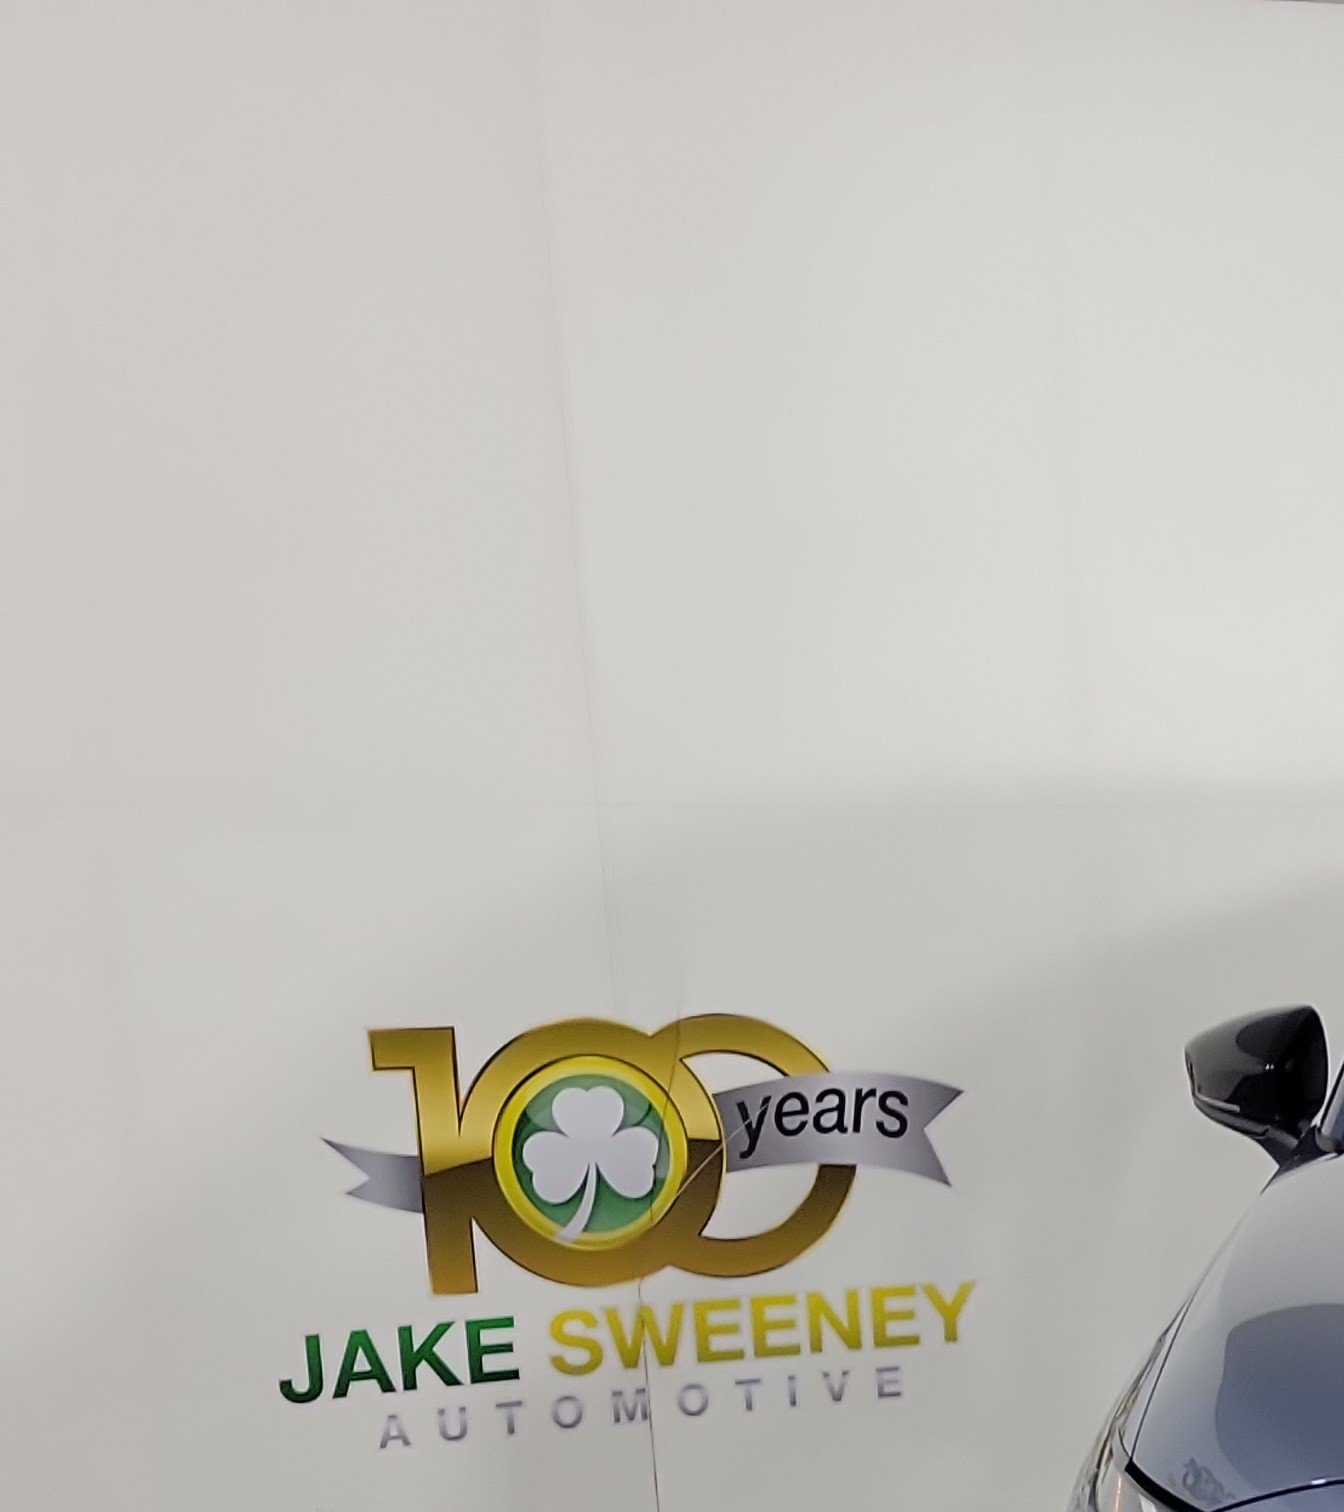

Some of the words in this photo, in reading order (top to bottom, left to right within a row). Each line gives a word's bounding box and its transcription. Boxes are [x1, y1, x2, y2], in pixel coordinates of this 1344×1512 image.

[737, 1086, 910, 1159] years
[278, 1316, 520, 1403] JAKE
[548, 1281, 976, 1376] SWEENEY
[378, 1366, 903, 1449] AUTOMOTIVE
